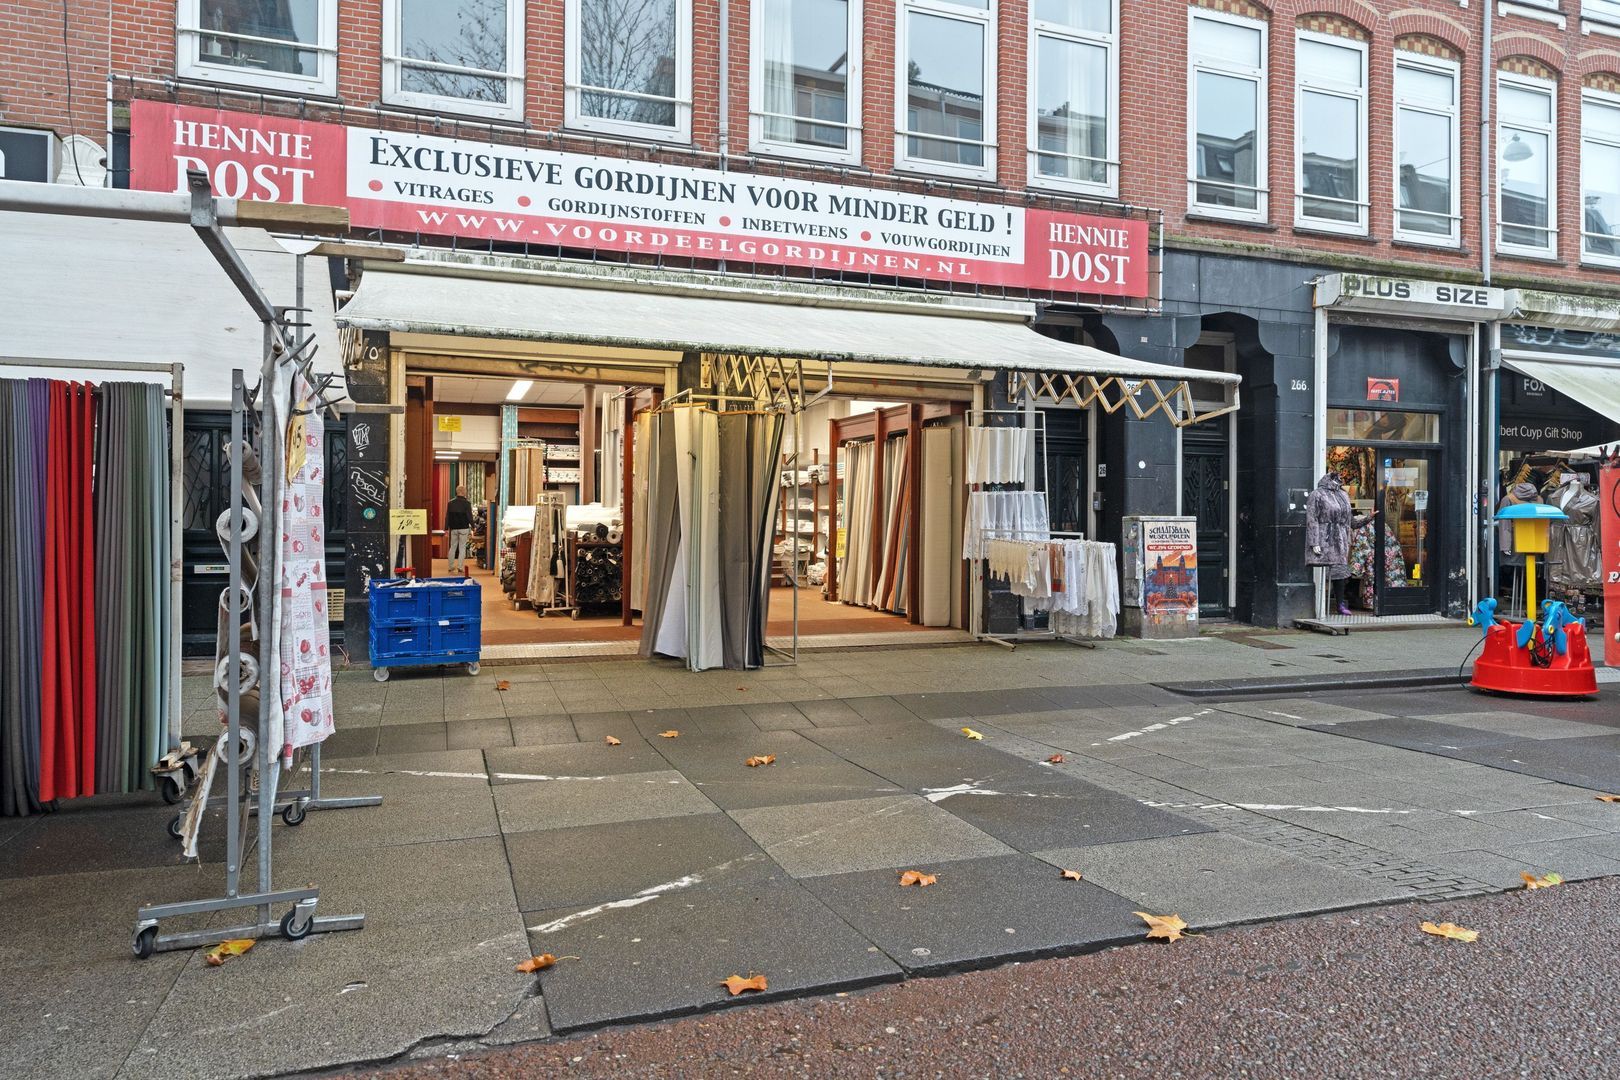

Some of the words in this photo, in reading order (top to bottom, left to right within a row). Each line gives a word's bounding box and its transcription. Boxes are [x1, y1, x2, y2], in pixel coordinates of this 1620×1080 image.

[173, 120, 312, 160] HENNIE
[173, 155, 314, 205] DOST
[370, 136, 562, 186] EXCLUSIEVE
[574, 166, 736, 204] GORDIJNEN
[747, 185, 819, 213] VOOR
[828, 193, 929, 226] MINDER
[938, 208, 995, 233] GELD
[1006, 212, 1013, 236] !
[393, 180, 494, 205] VITRAGES
[548, 197, 706, 226] GORDIJNSTOFFEN
[742, 217, 848, 240] INBETWEENS
[1048, 222, 1130, 250] HENNIE
[881, 232, 1011, 258] VOUWGORDIJNEN
[1048, 249, 1131, 285] DOST
[1345, 280, 1411, 300] PLUS
[1436, 286, 1489, 306] SIZE
[1523, 378, 1546, 392] FOX
[1500, 424, 1518, 437] bert
[1520, 425, 1543, 441] Cuyp
[1544, 426, 1560, 439] Gift
[1561, 427, 1584, 443] Shop
